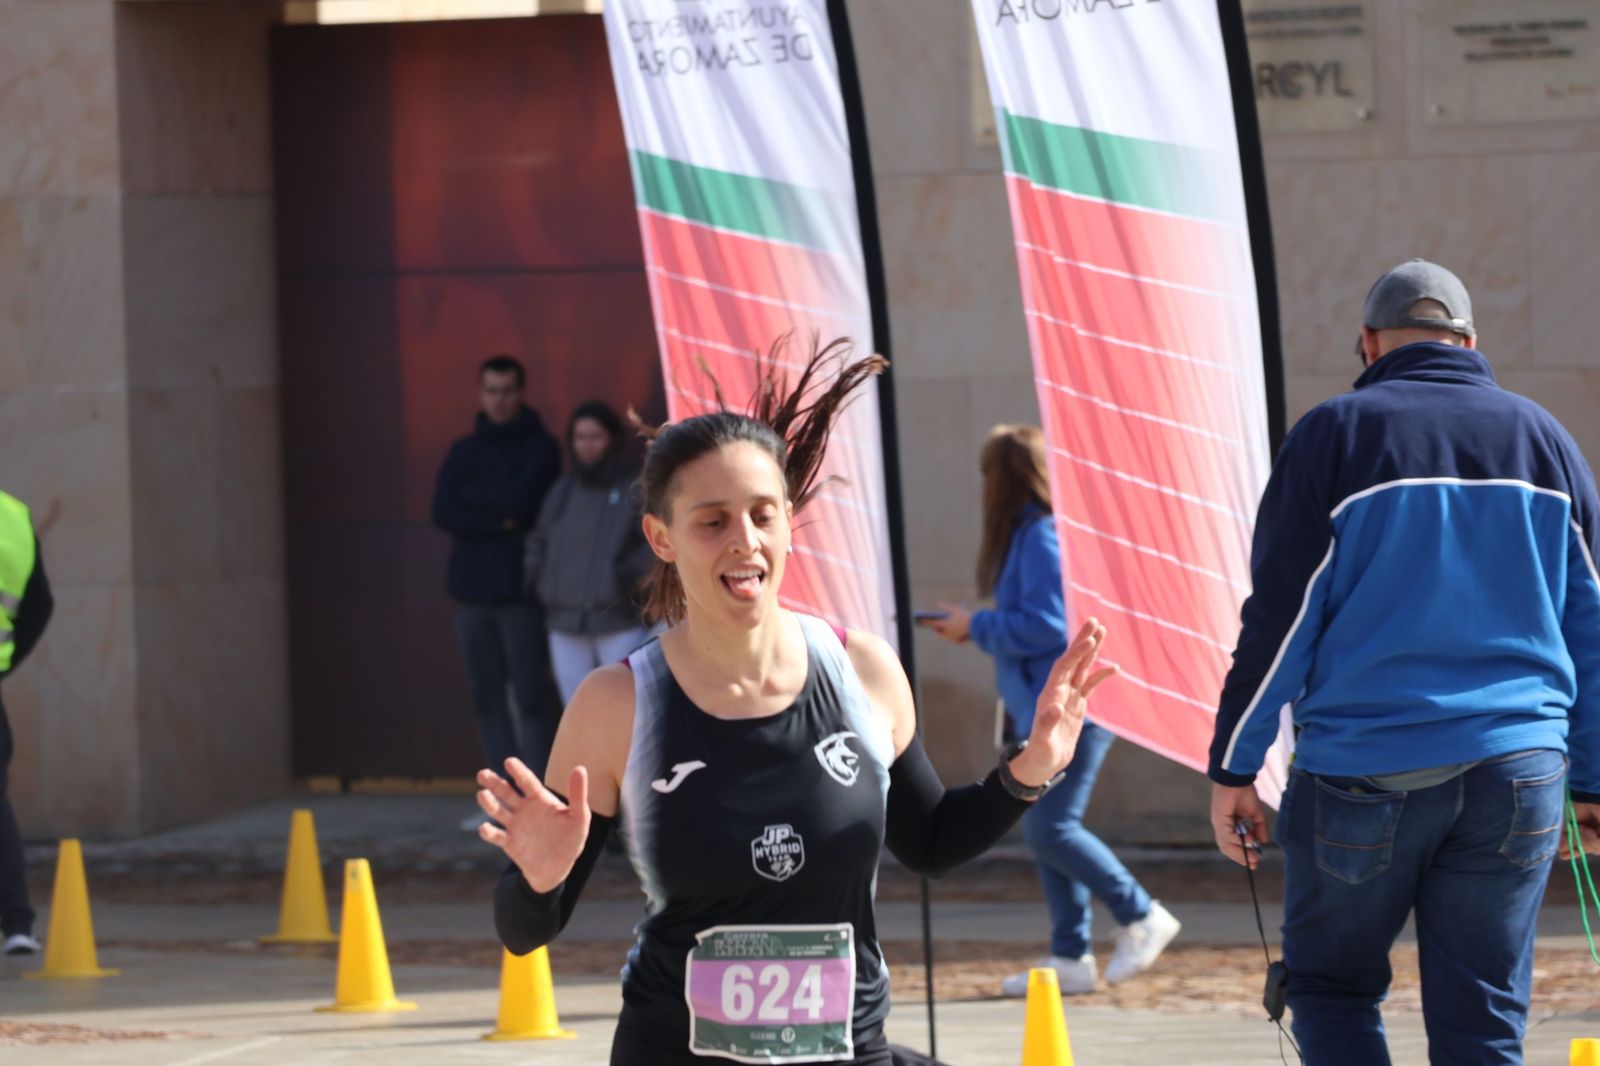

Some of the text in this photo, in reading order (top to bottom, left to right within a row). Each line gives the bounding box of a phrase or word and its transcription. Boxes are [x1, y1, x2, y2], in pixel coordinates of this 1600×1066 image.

[761, 827, 790, 846] JP
[755, 842, 801, 859] HYBRID
[720, 963, 825, 1022] 624
